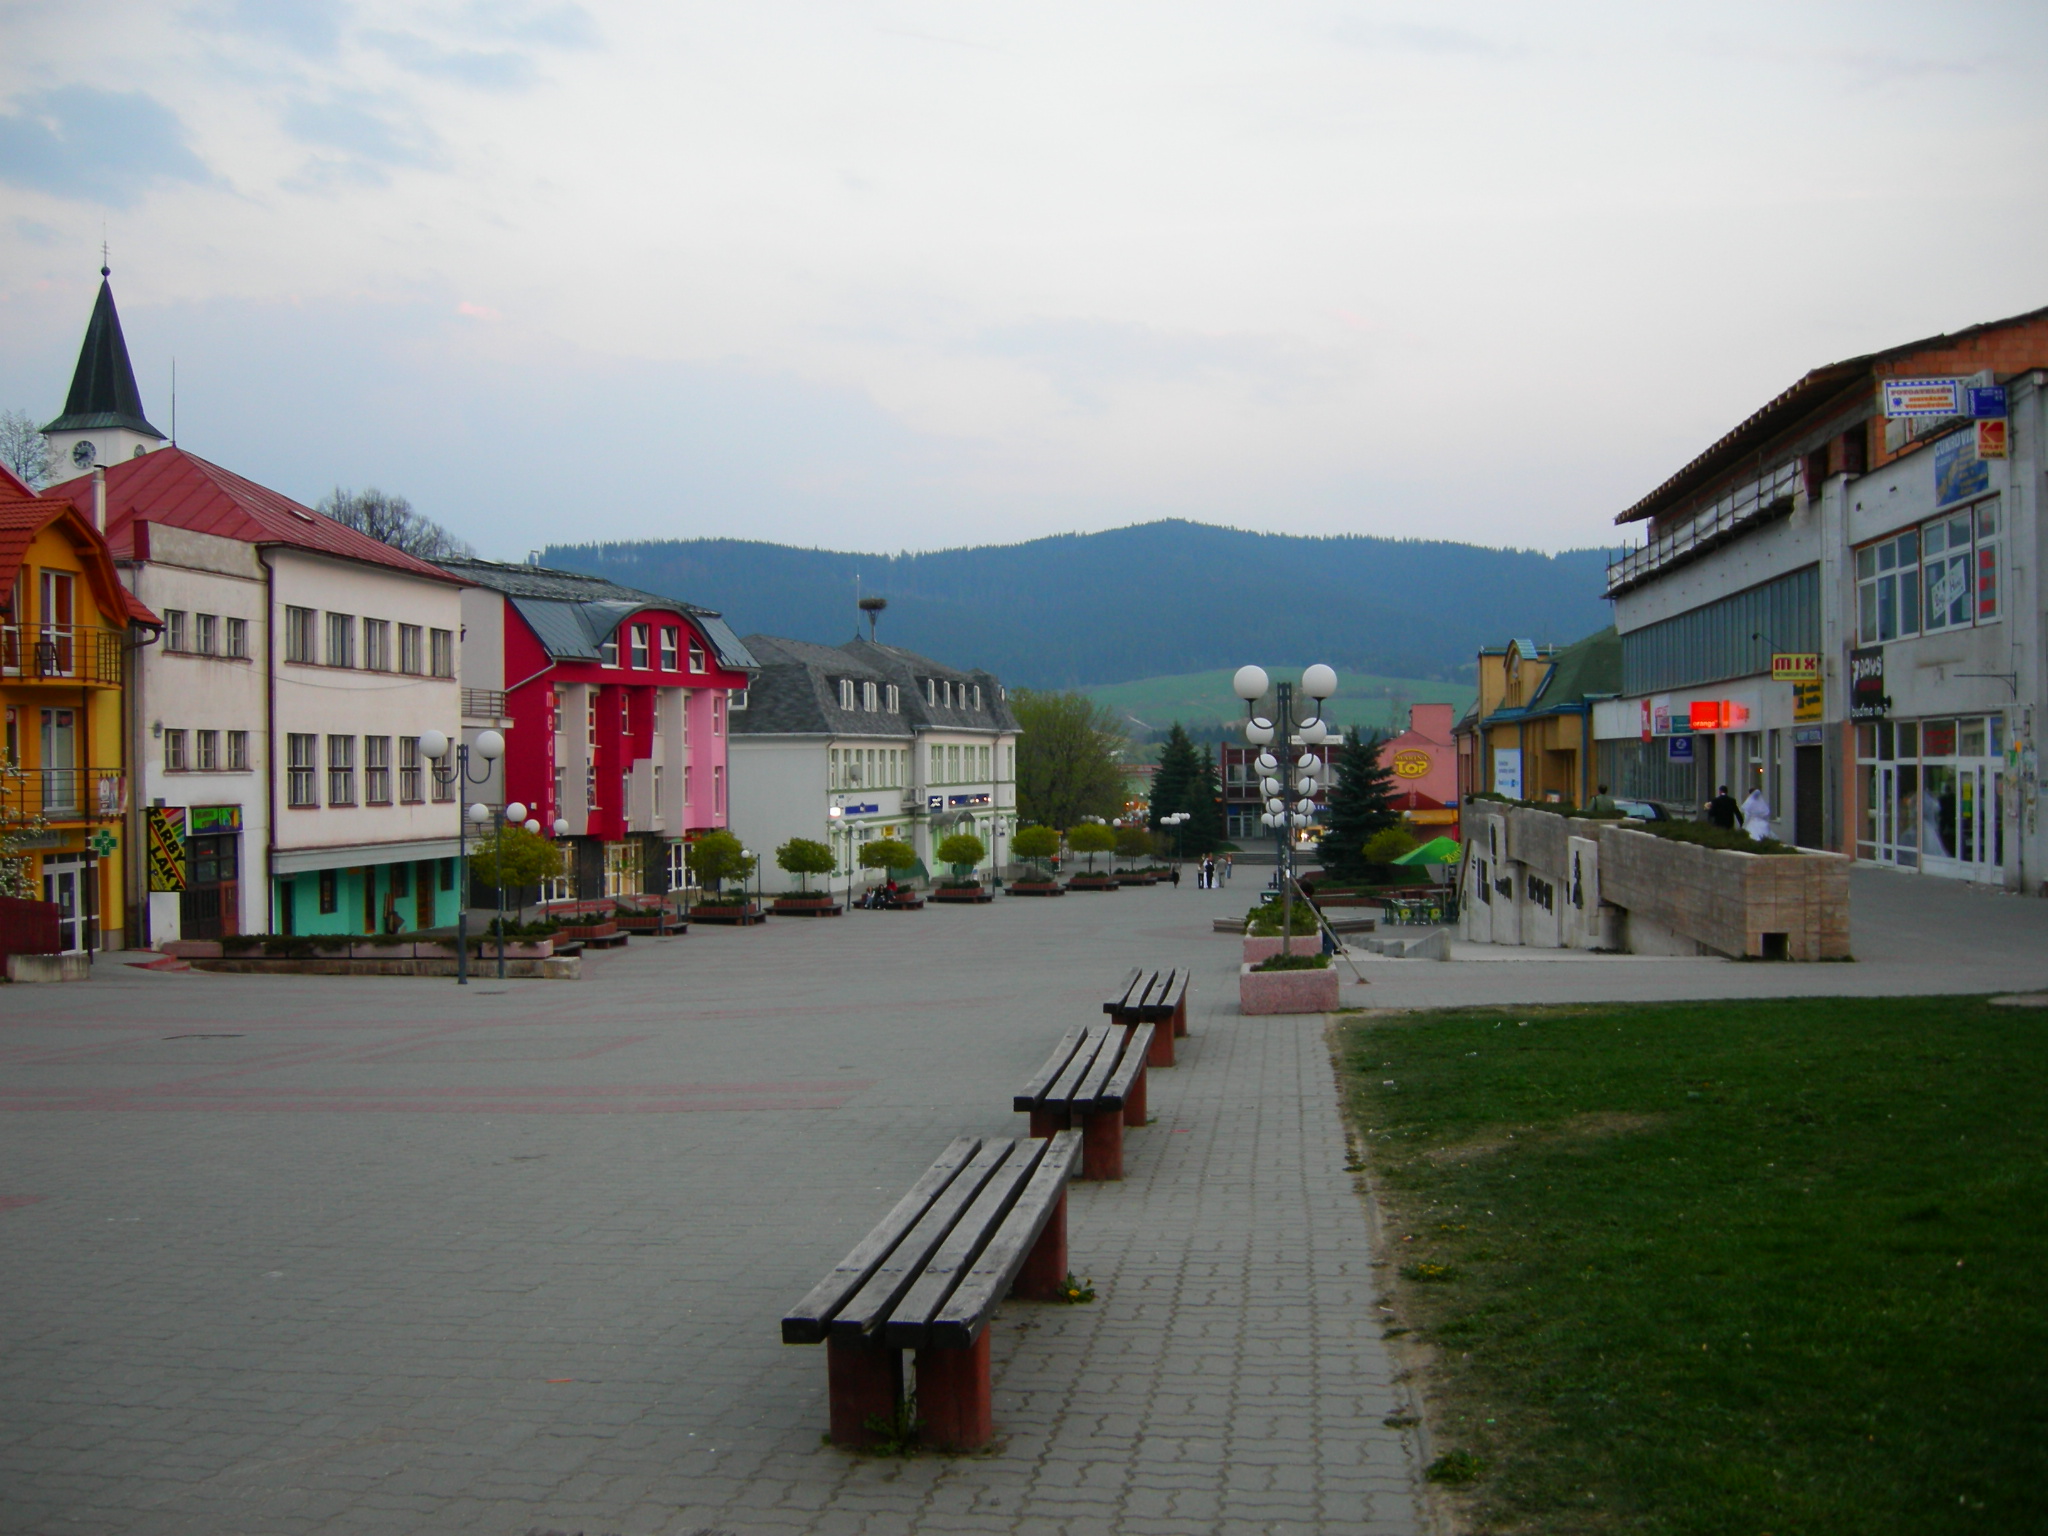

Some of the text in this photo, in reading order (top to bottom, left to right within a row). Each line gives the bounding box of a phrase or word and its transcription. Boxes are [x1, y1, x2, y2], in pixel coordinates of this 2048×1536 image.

[1692, 720, 1716, 728] orange
[546, 691, 555, 826] medium
[1395, 761, 1427, 774] TOP
[147, 808, 186, 862] FARBY
[150, 846, 185, 891] LAKY
